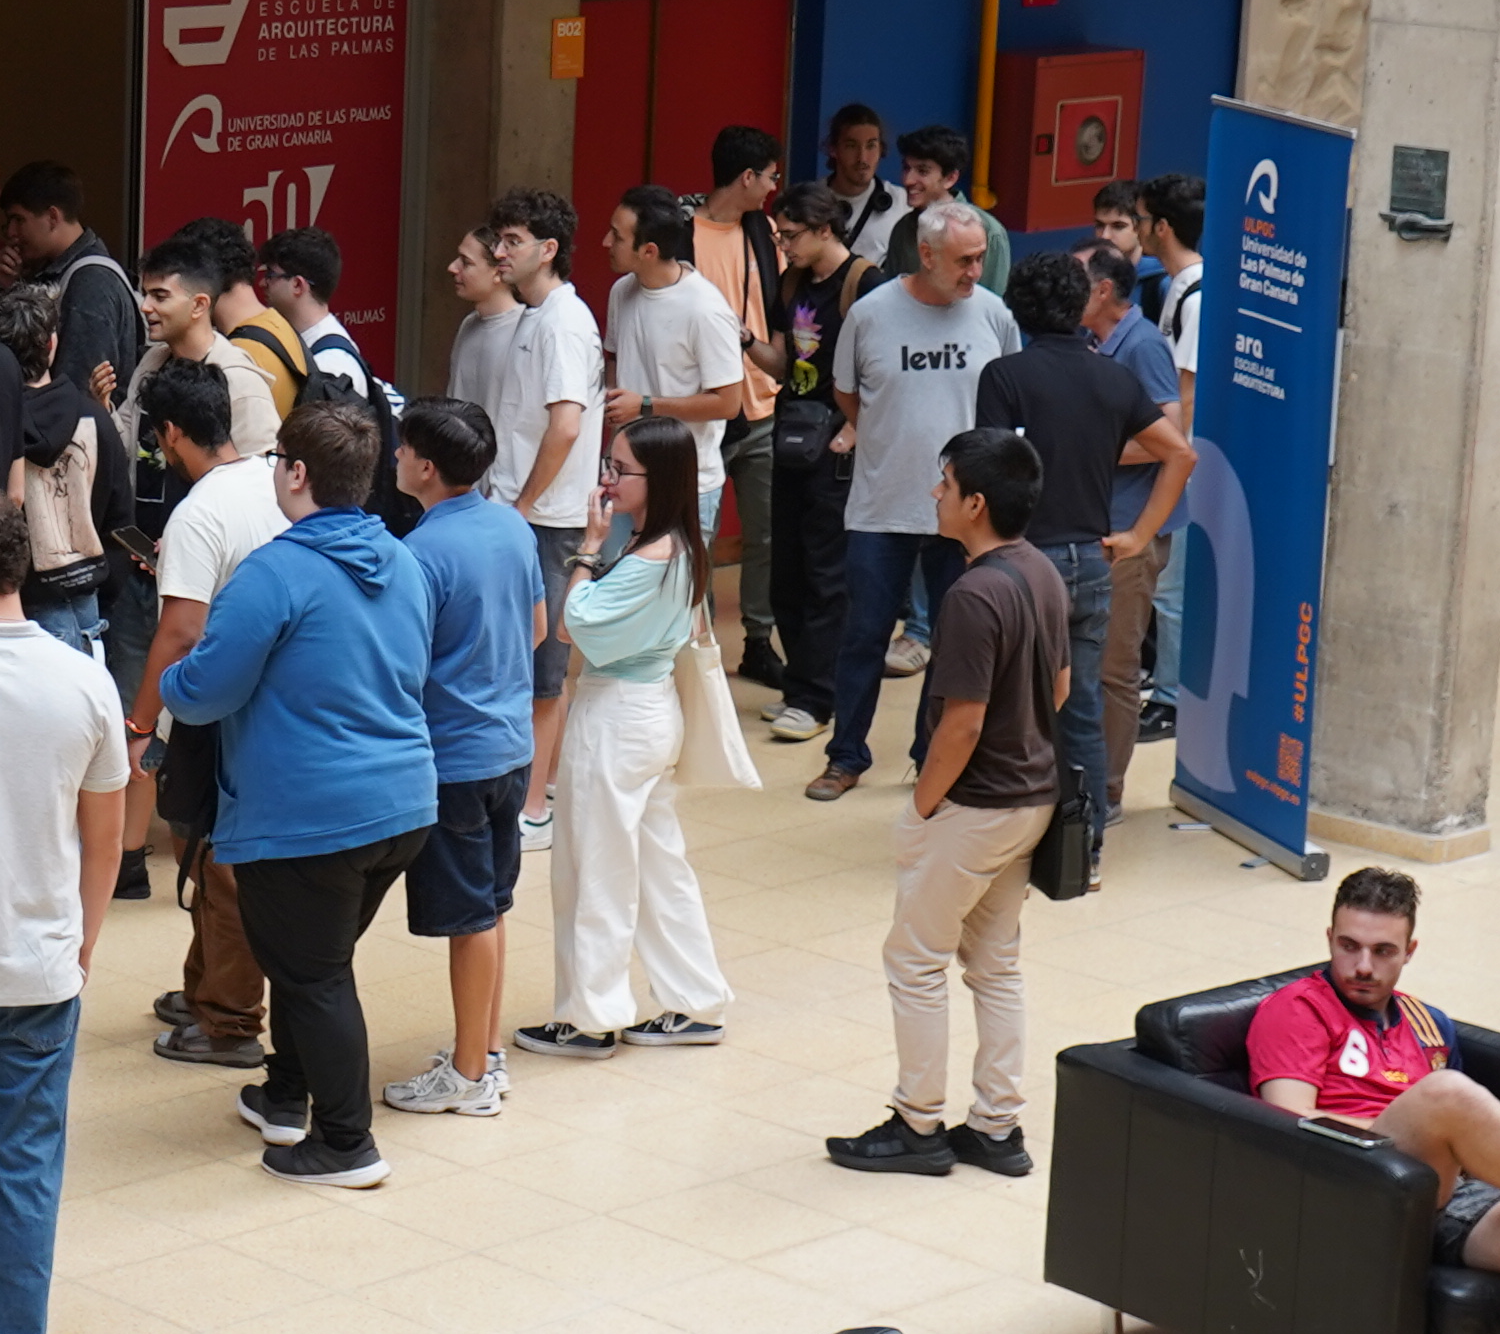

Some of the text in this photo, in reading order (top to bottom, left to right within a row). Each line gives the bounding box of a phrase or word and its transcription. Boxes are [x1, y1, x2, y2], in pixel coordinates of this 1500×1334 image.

[258, 15, 395, 40] ARQUITECTURA
[557, 21, 582, 37] B02
[257, 37, 394, 62] DE LAS PALMAS
[227, 104, 392, 133] UNIVERSIDAD DE LAS PALMAS
[227, 129, 333, 152] DE GRAN CANARIA
[1243, 216, 1275, 239] ULPGC
[1241, 233, 1308, 269] Universidad de
[1240, 253, 1306, 288] Las Palmas de
[1239, 272, 1299, 306] Gran Canaria
[343, 307, 386, 325] PALMAS
[901, 343, 967, 371] levi's
[1293, 601, 1314, 723] #ULPGC
[1338, 1028, 1370, 1078] 6
